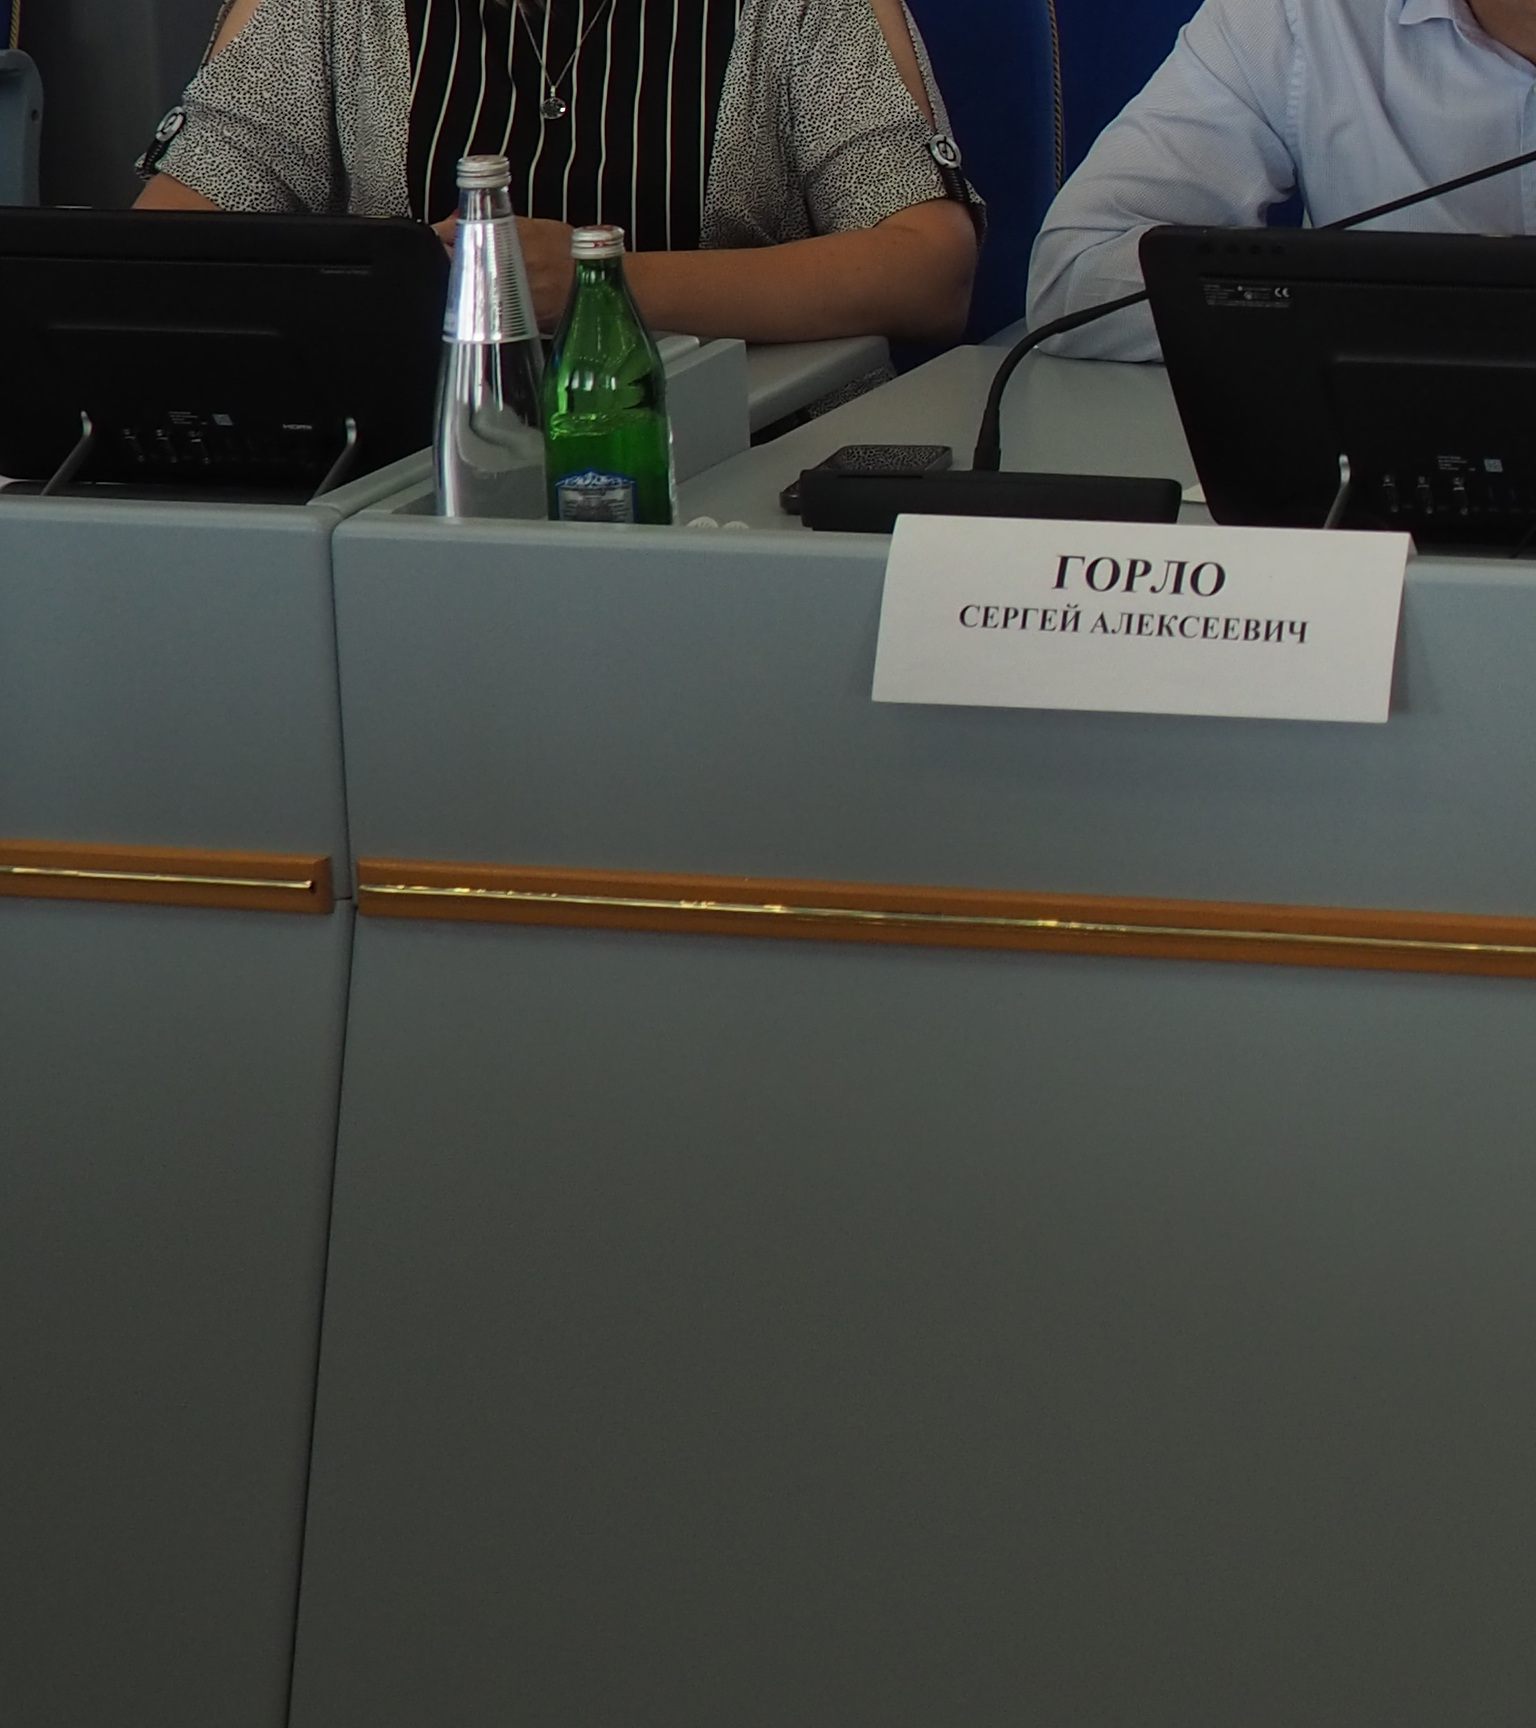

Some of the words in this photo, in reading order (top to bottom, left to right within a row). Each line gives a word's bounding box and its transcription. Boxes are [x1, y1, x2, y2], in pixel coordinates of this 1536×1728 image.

[1051, 554, 1228, 598] ГОРЛО
[958, 602, 1082, 633] СЕРГЕЙ
[1089, 611, 1309, 645] АЛЕКСЕЕВИЧ
